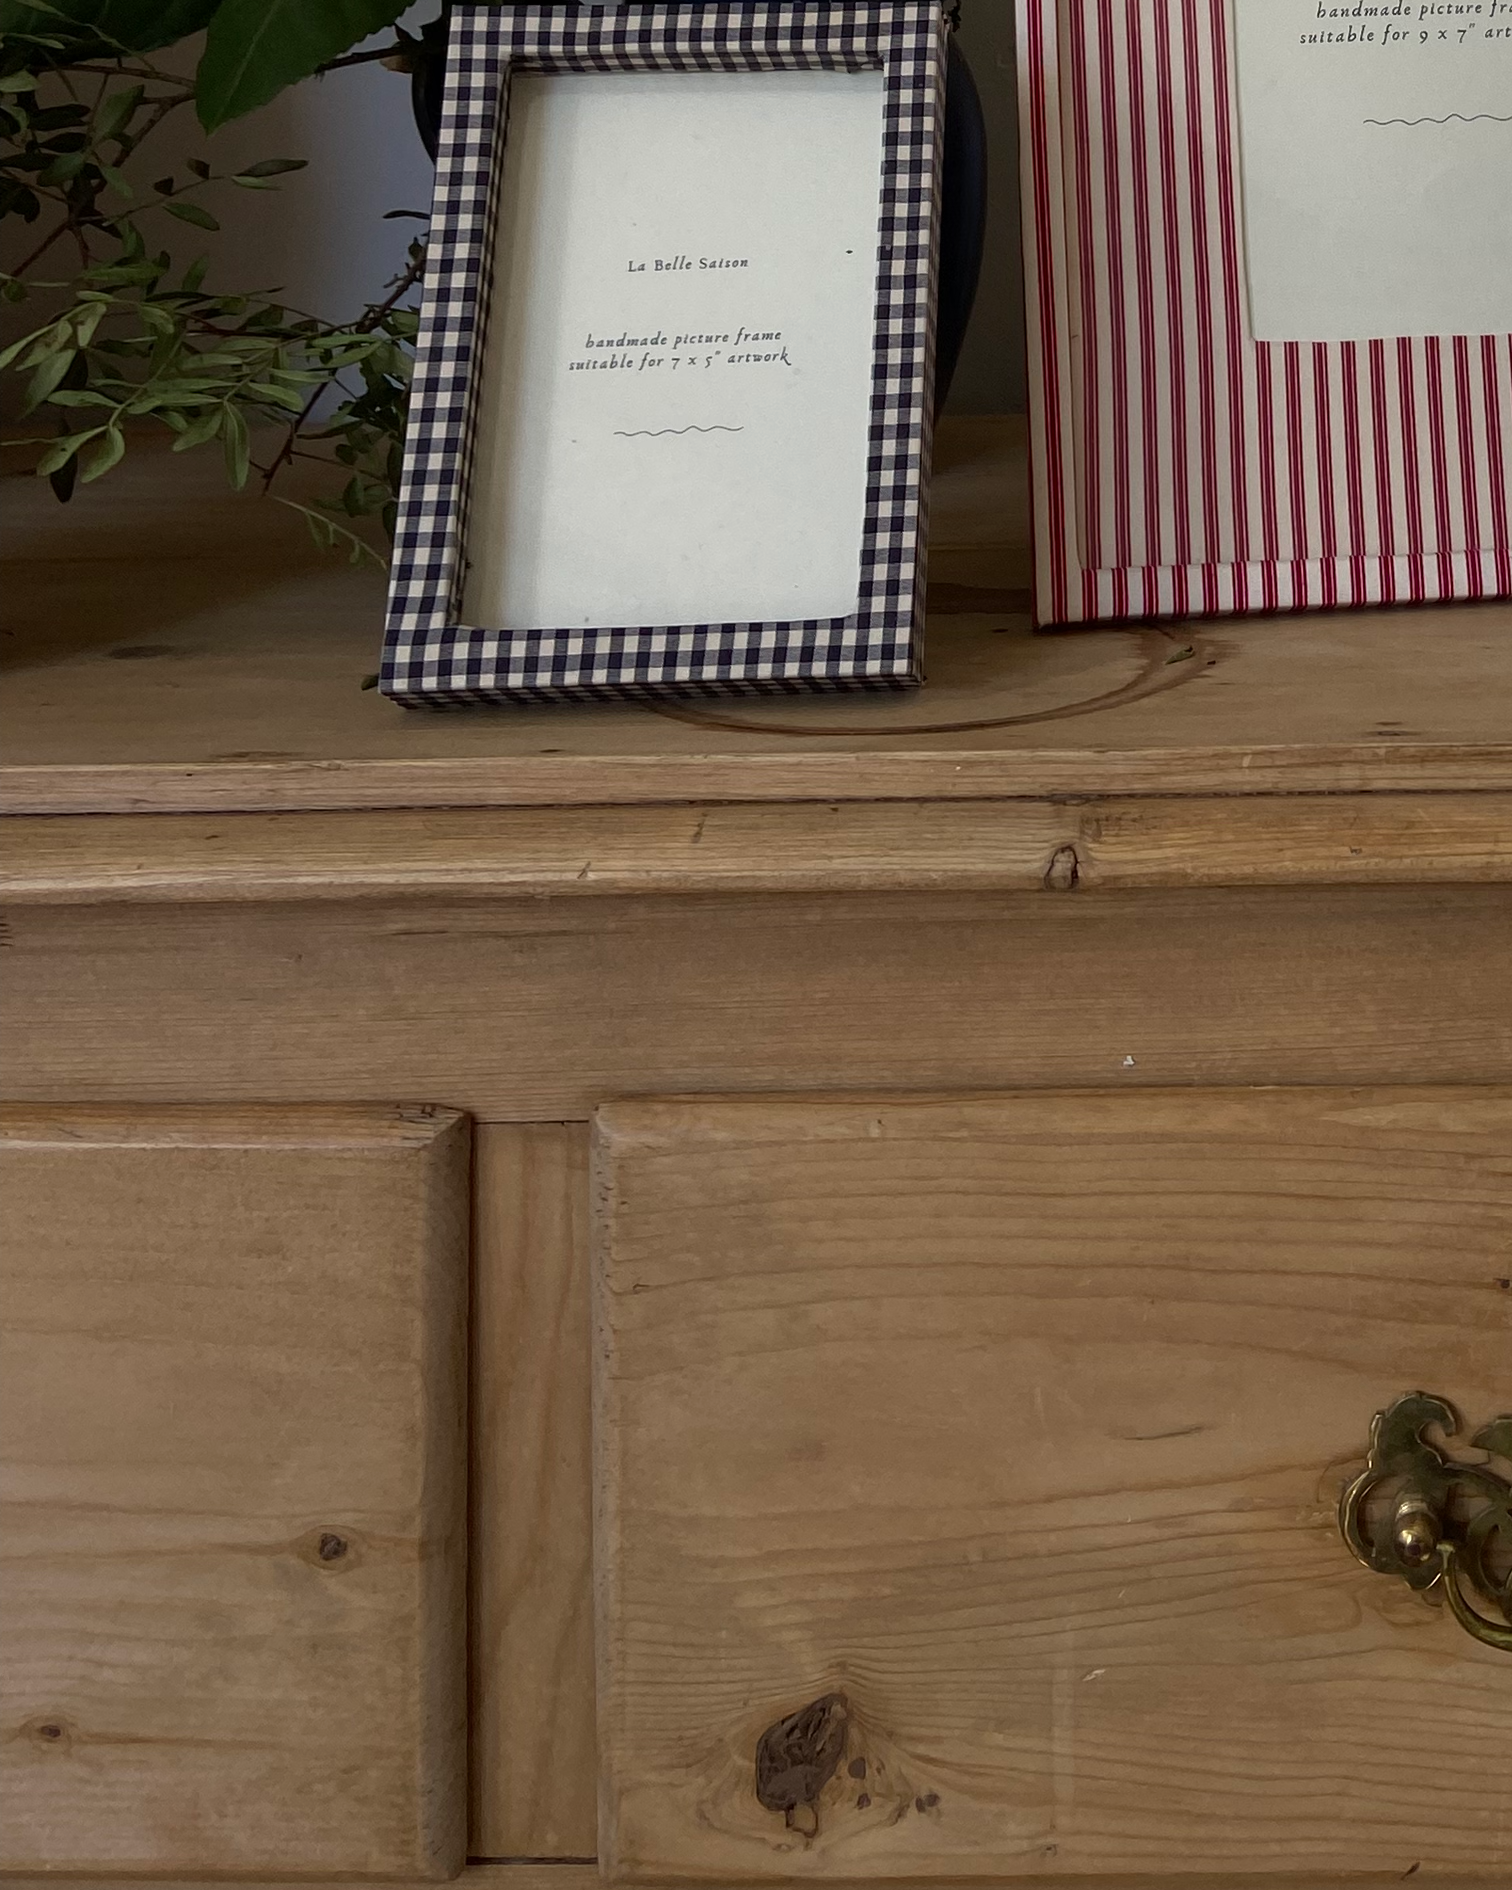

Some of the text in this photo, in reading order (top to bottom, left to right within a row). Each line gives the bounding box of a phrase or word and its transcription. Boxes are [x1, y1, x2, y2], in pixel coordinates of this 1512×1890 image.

[1417, 2, 1483, 22] picture
[1299, 24, 1375, 45] suitable
[1380, 23, 1410, 46] for
[1419, 30, 1429, 45] 9
[1437, 29, 1448, 41] x
[627, 254, 750, 273] La Belle Saison
[584, 326, 782, 351] handmade picture frame
[568, 352, 634, 372] suitable
[637, 351, 665, 372] for
[670, 357, 681, 371] 7
[687, 355, 698, 367] x
[727, 345, 793, 367] artwork
